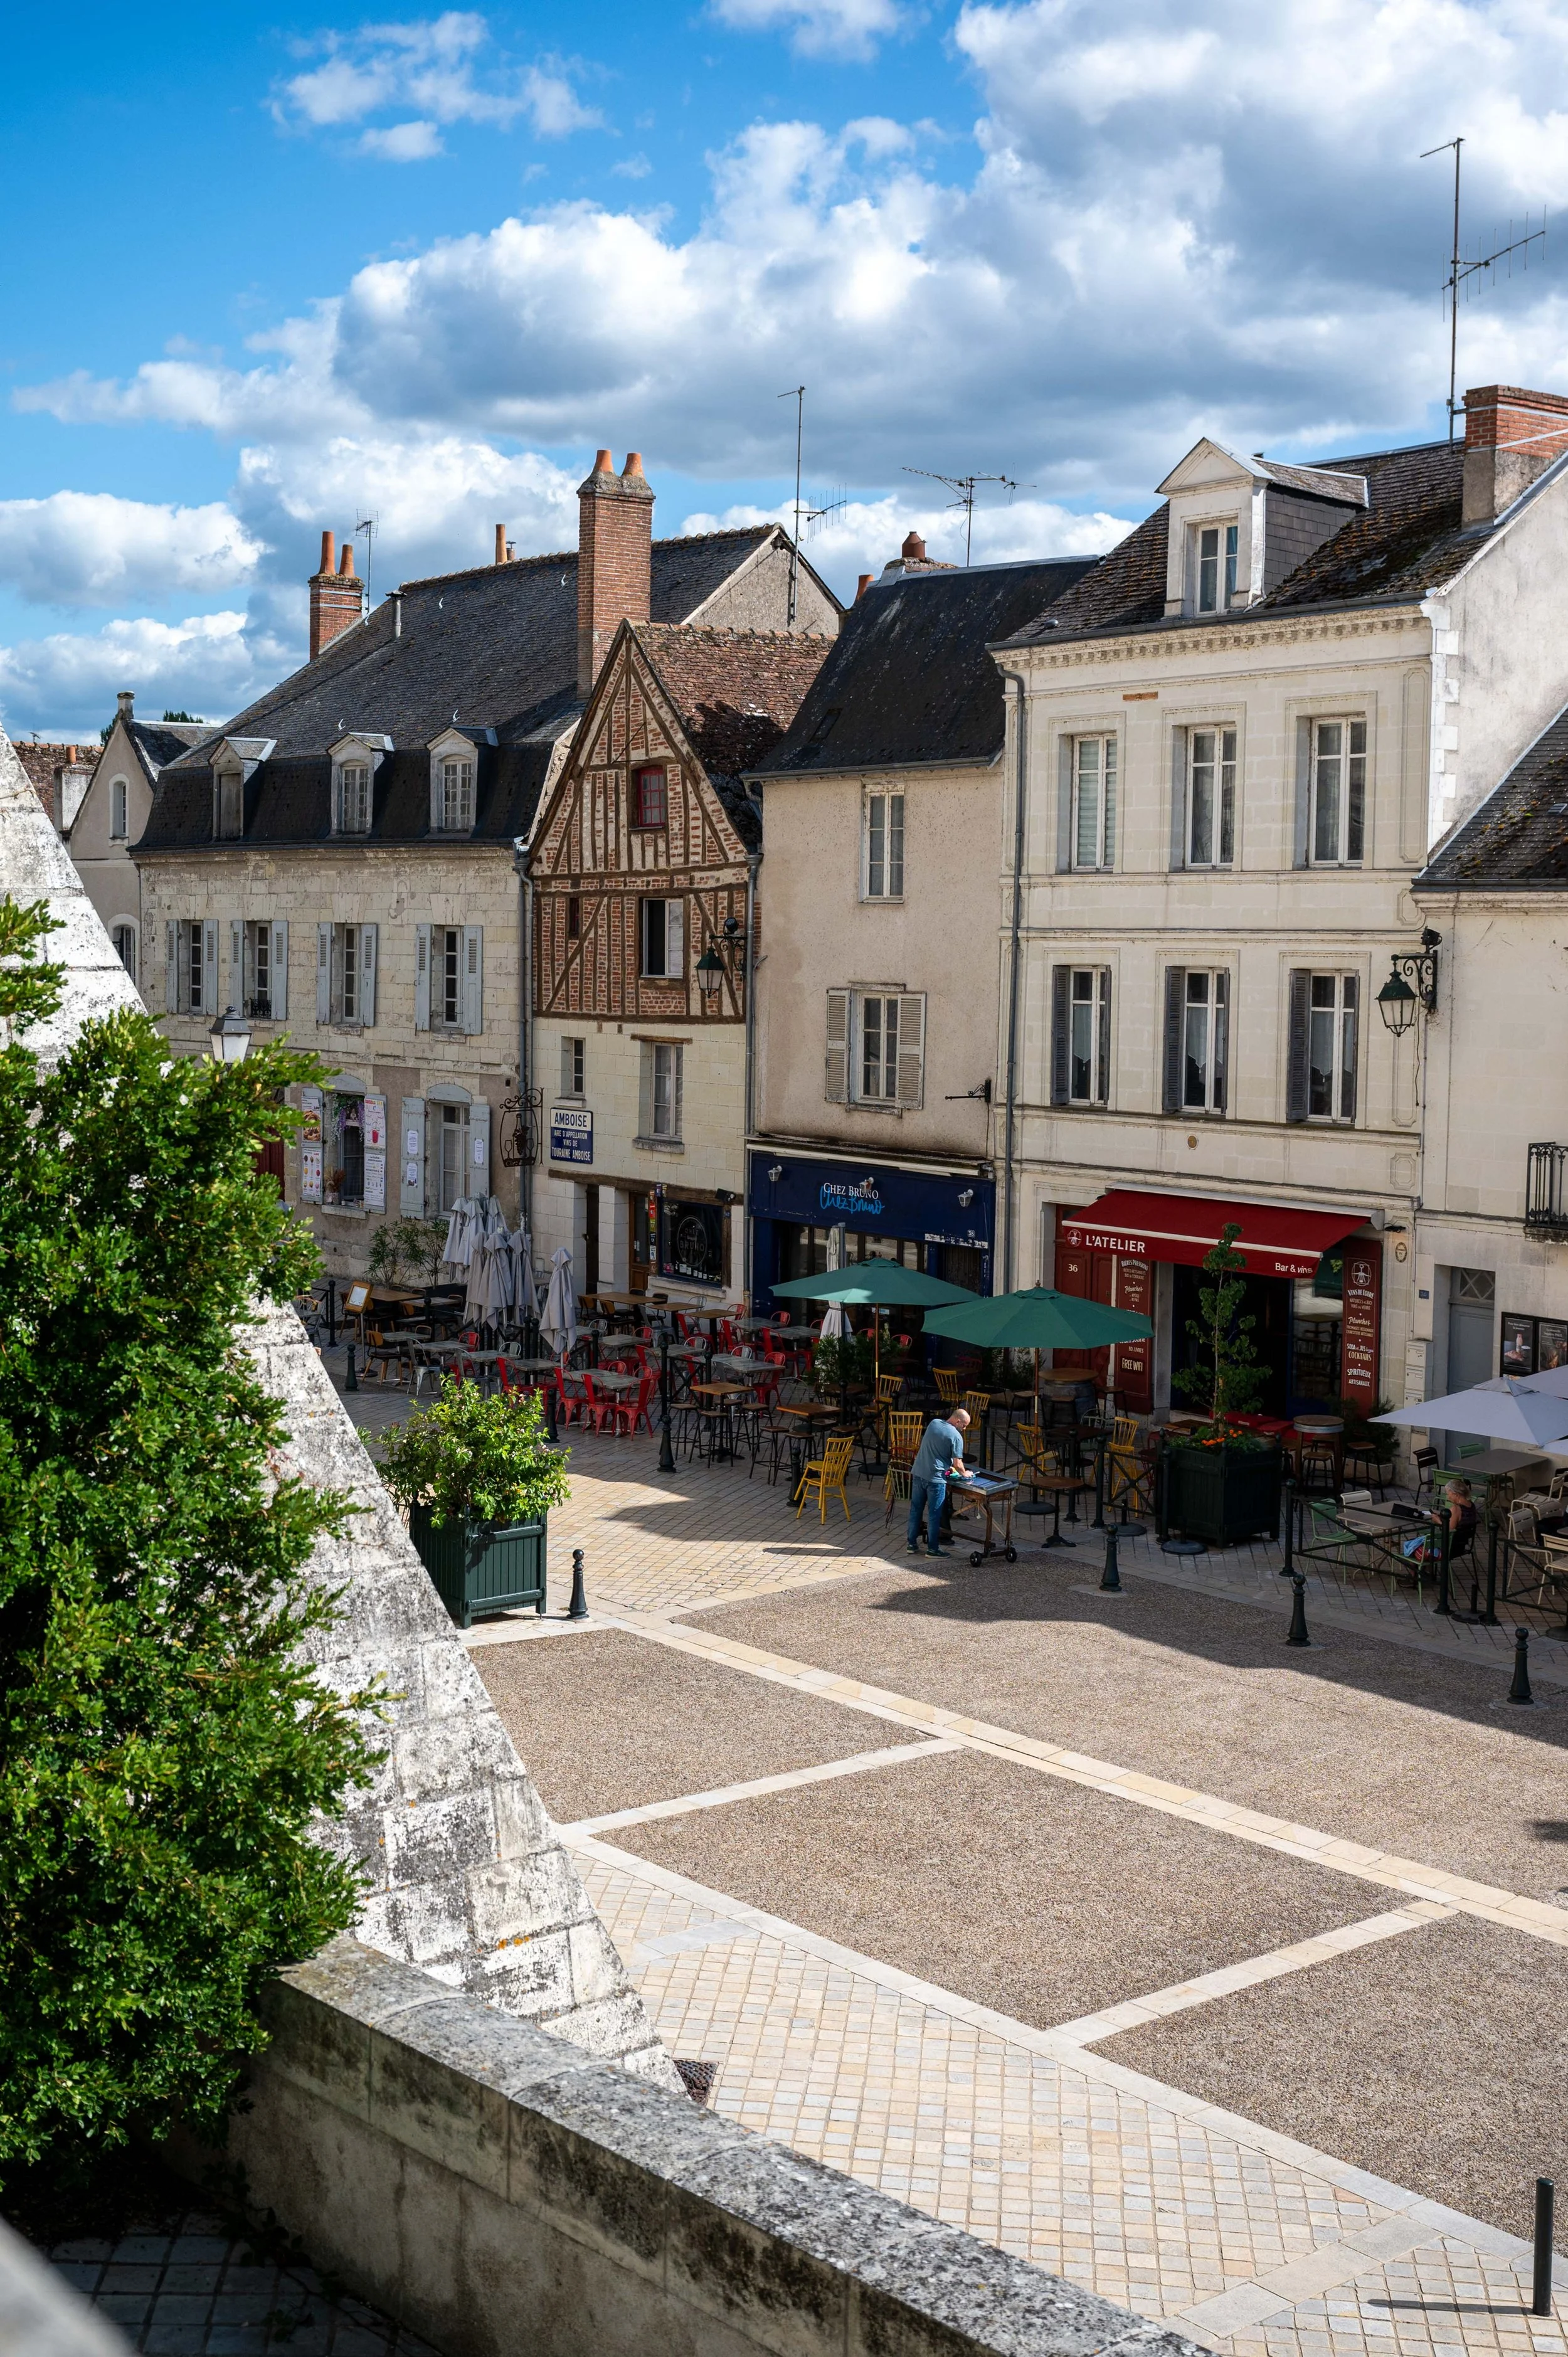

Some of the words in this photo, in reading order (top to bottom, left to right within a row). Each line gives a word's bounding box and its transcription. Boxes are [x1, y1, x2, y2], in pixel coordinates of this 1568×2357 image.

[554, 1113, 587, 1127] AMBOISE
[563, 1131, 588, 1140] D'APPELLATION
[552, 1147, 571, 1158] TOURAINE
[572, 1150, 591, 1161] AMBOISE
[824, 1182, 846, 1195] CHEZ
[849, 1185, 879, 1199] BRUNO
[820, 1185, 849, 1210] Chez
[849, 1194, 885, 1214] Bruno
[680, 1240, 704, 1251] BRUNO
[1086, 1235, 1145, 1253] L'ATELIER
[1068, 1264, 1078, 1272] 36
[1132, 1259, 1149, 1271] PRESSIONS
[1275, 1263, 1288, 1272] Bar
[1290, 1264, 1296, 1273] &
[1125, 1285, 1143, 1294] Planches
[1362, 1290, 1374, 1299] LOIRE
[1348, 1317, 1371, 1326] Planches
[1348, 1351, 1372, 1361] COCKTAILS
[1122, 1358, 1132, 1369] FREE
[1133, 1361, 1143, 1372] WIFI
[1347, 1369, 1372, 1379] SPIRITUEUX
[1348, 1379, 1370, 1387] ARTISANAUX
